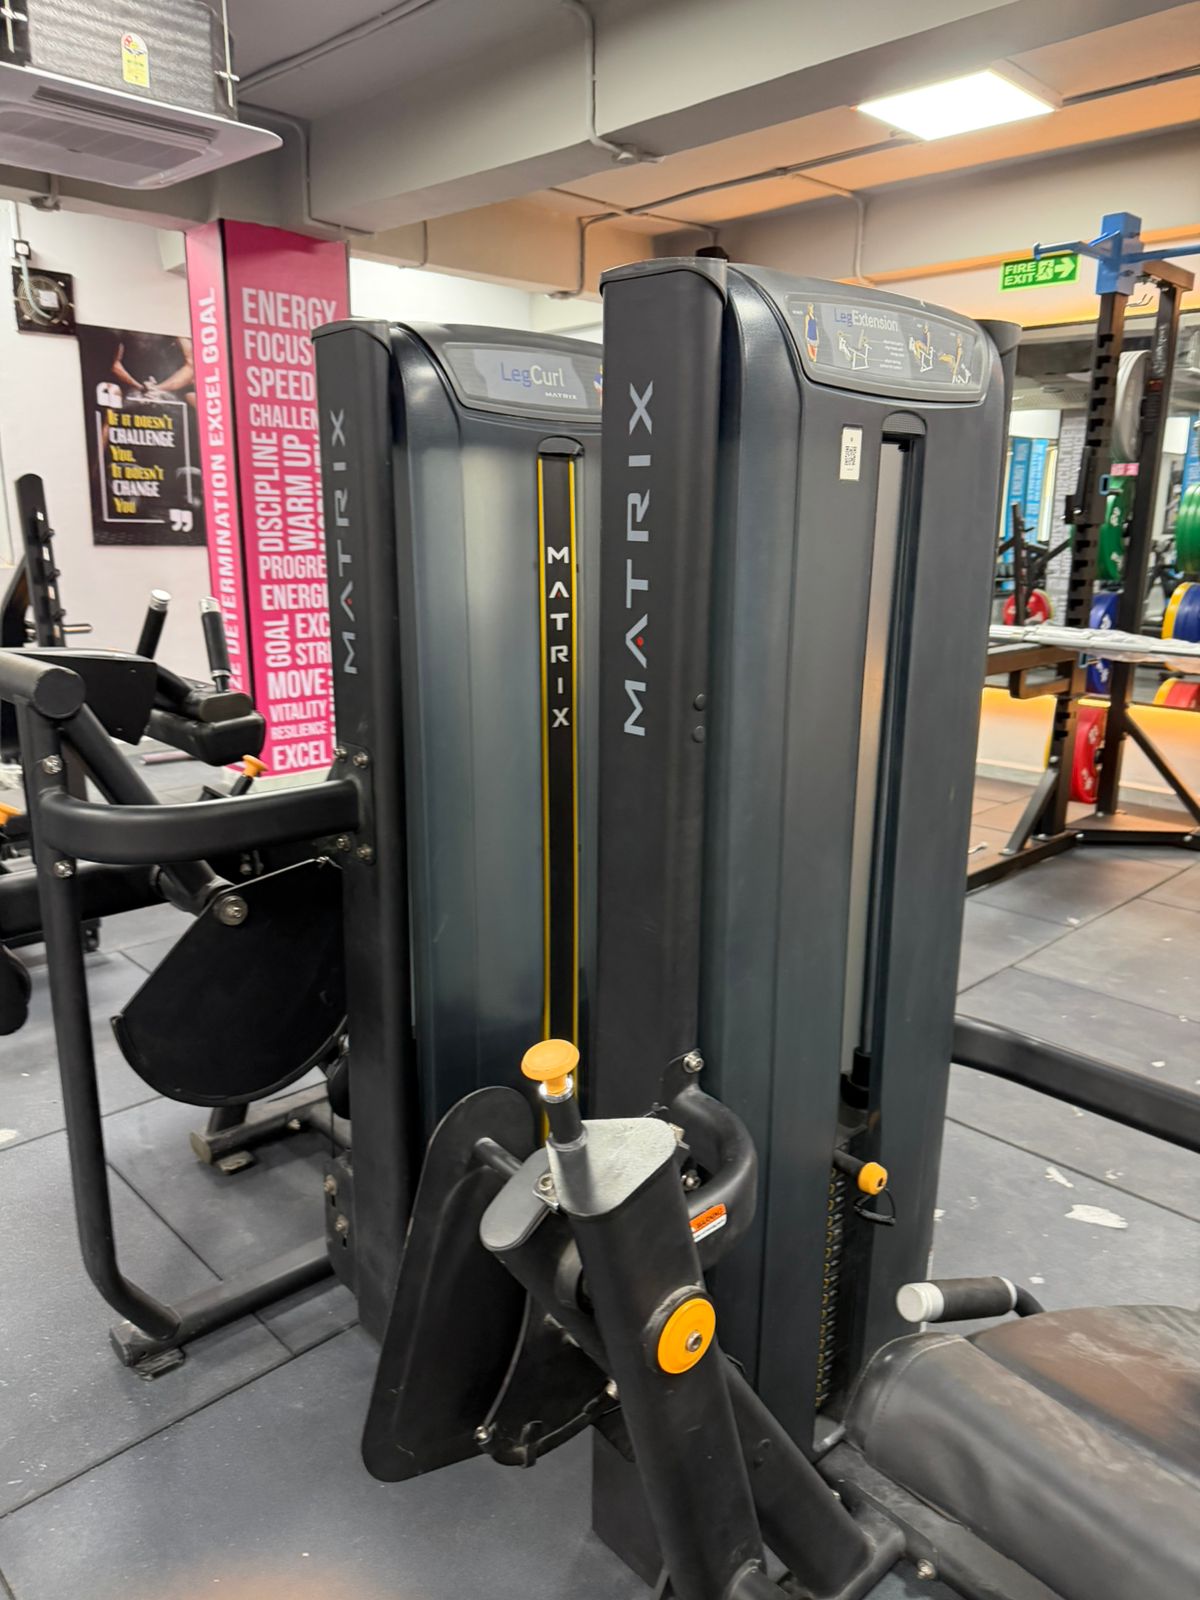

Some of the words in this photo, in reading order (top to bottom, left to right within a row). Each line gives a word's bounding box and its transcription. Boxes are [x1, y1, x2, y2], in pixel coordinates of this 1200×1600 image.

[1004, 272, 1035, 286] EXIT
[1005, 262, 1037, 275] FIRE
[198, 287, 220, 364] GOAL
[242, 287, 337, 330] ENERGY
[243, 329, 313, 366] FOCUS
[246, 366, 315, 401] SPEED
[204, 368, 225, 447] EXCEL
[282, 434, 312, 468] UP
[251, 430, 285, 552] DISCIPLINE
[284, 474, 317, 551] WARM
[329, 408, 358, 675] MATRIX
[624, 379, 653, 737] MATRIX
[258, 554, 328, 580] PROGRE
[263, 613, 292, 668] GOAL
[547, 546, 570, 728] MATRIX
[267, 668, 327, 700] MOVE
[268, 699, 328, 723] VITALITY
[271, 720, 329, 741] RESILIENCE
[272, 740, 332, 771] EXCEL
